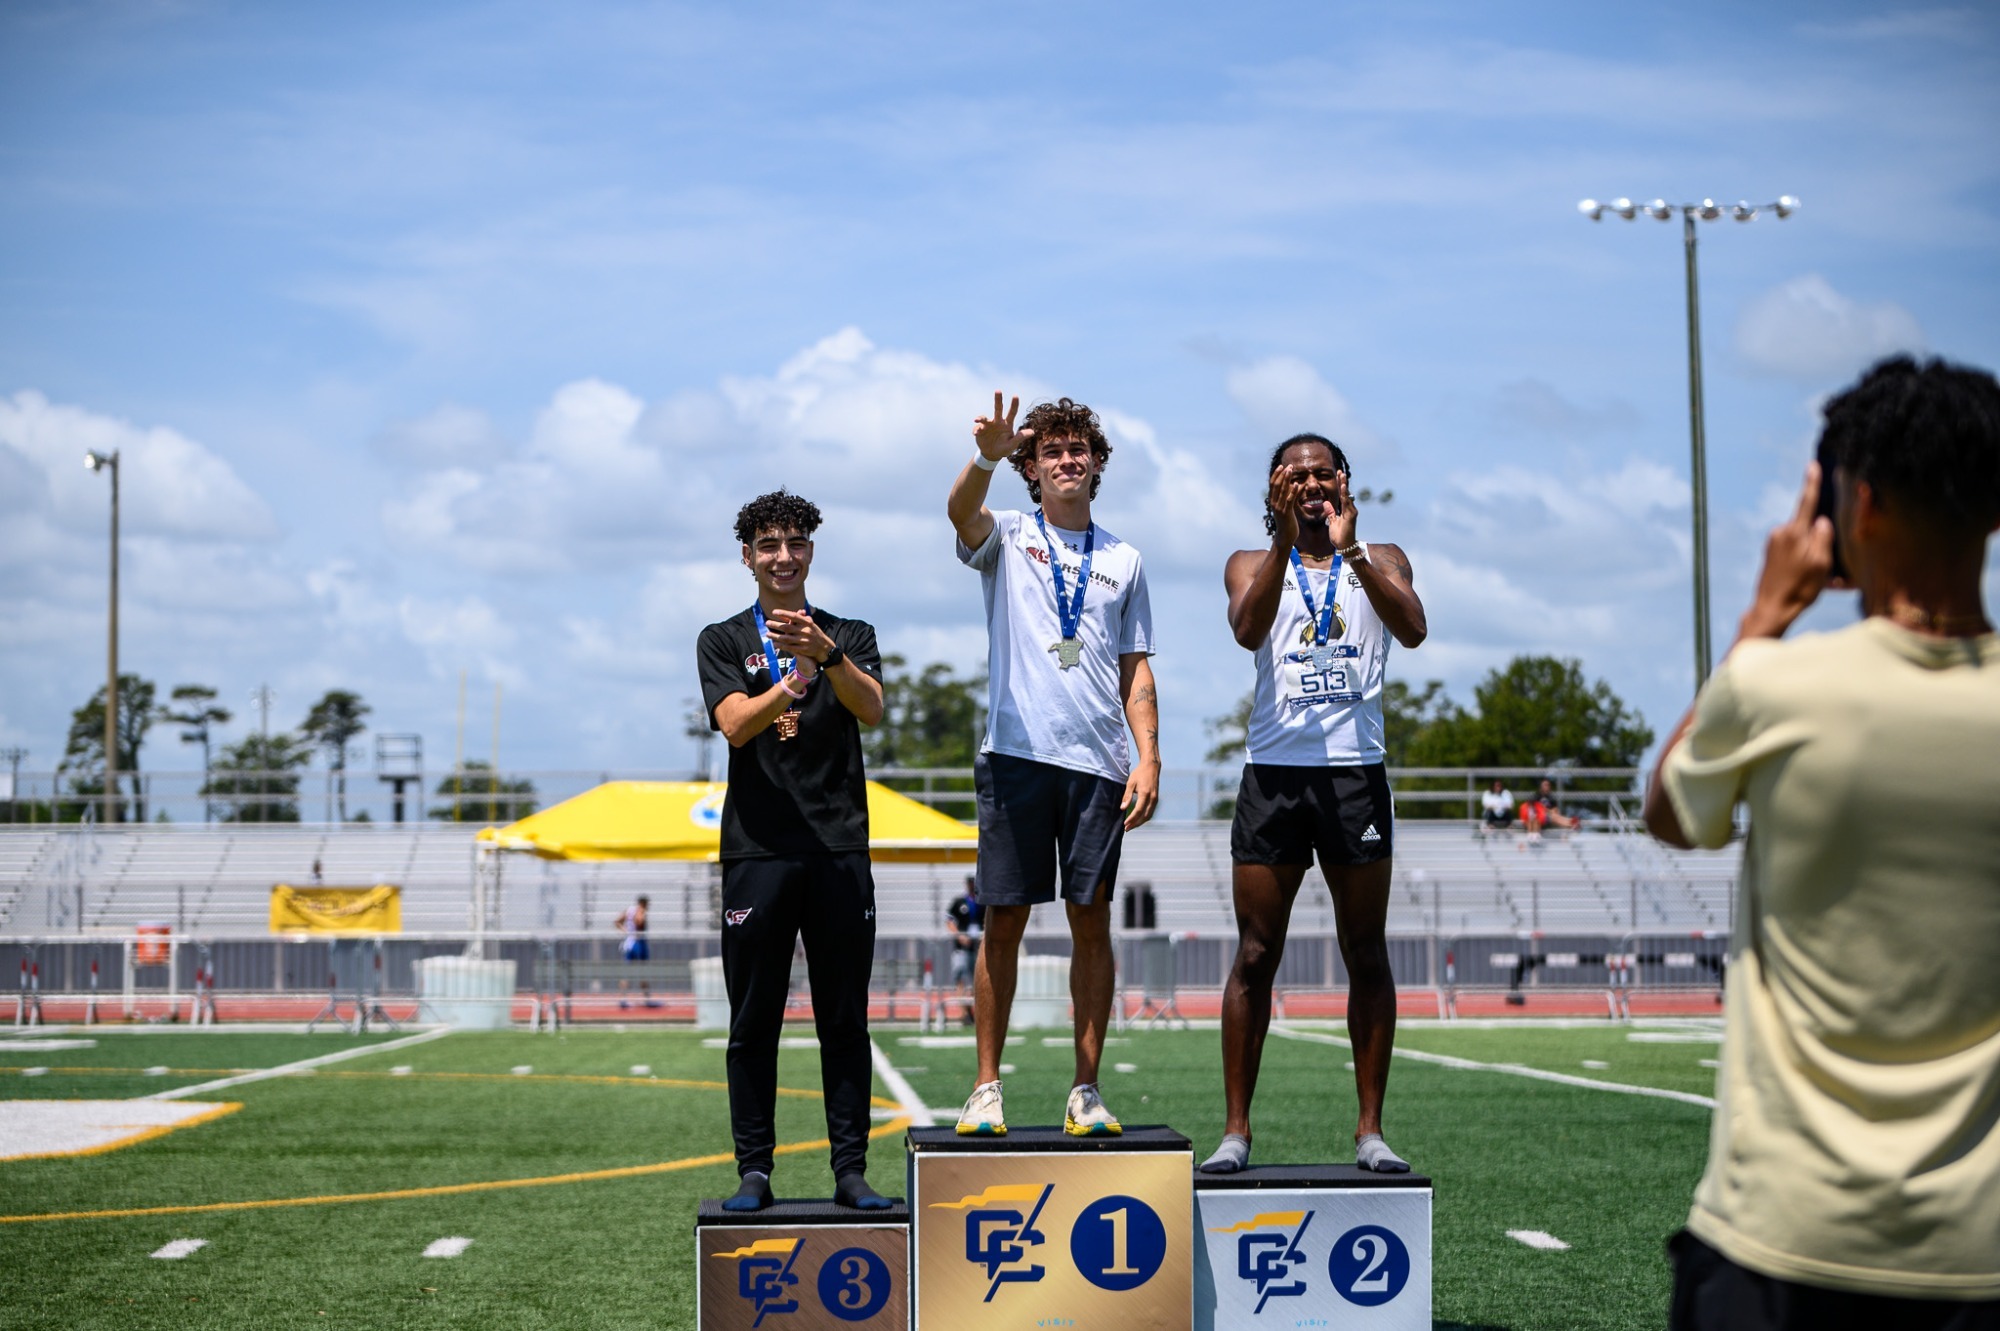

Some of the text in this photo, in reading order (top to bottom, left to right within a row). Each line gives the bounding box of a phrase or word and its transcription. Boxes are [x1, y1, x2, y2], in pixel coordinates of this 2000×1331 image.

[1059, 562, 1119, 590] RSKINE
[1301, 671, 1347, 694] 513
[1361, 833, 1381, 841] adidas
[1100, 1207, 1139, 1275] 1
[1350, 1234, 1389, 1292] 2
[838, 1256, 872, 1310] 3
[1036, 1317, 1075, 1328] VISIT
[1296, 1318, 1328, 1328] VISIT
